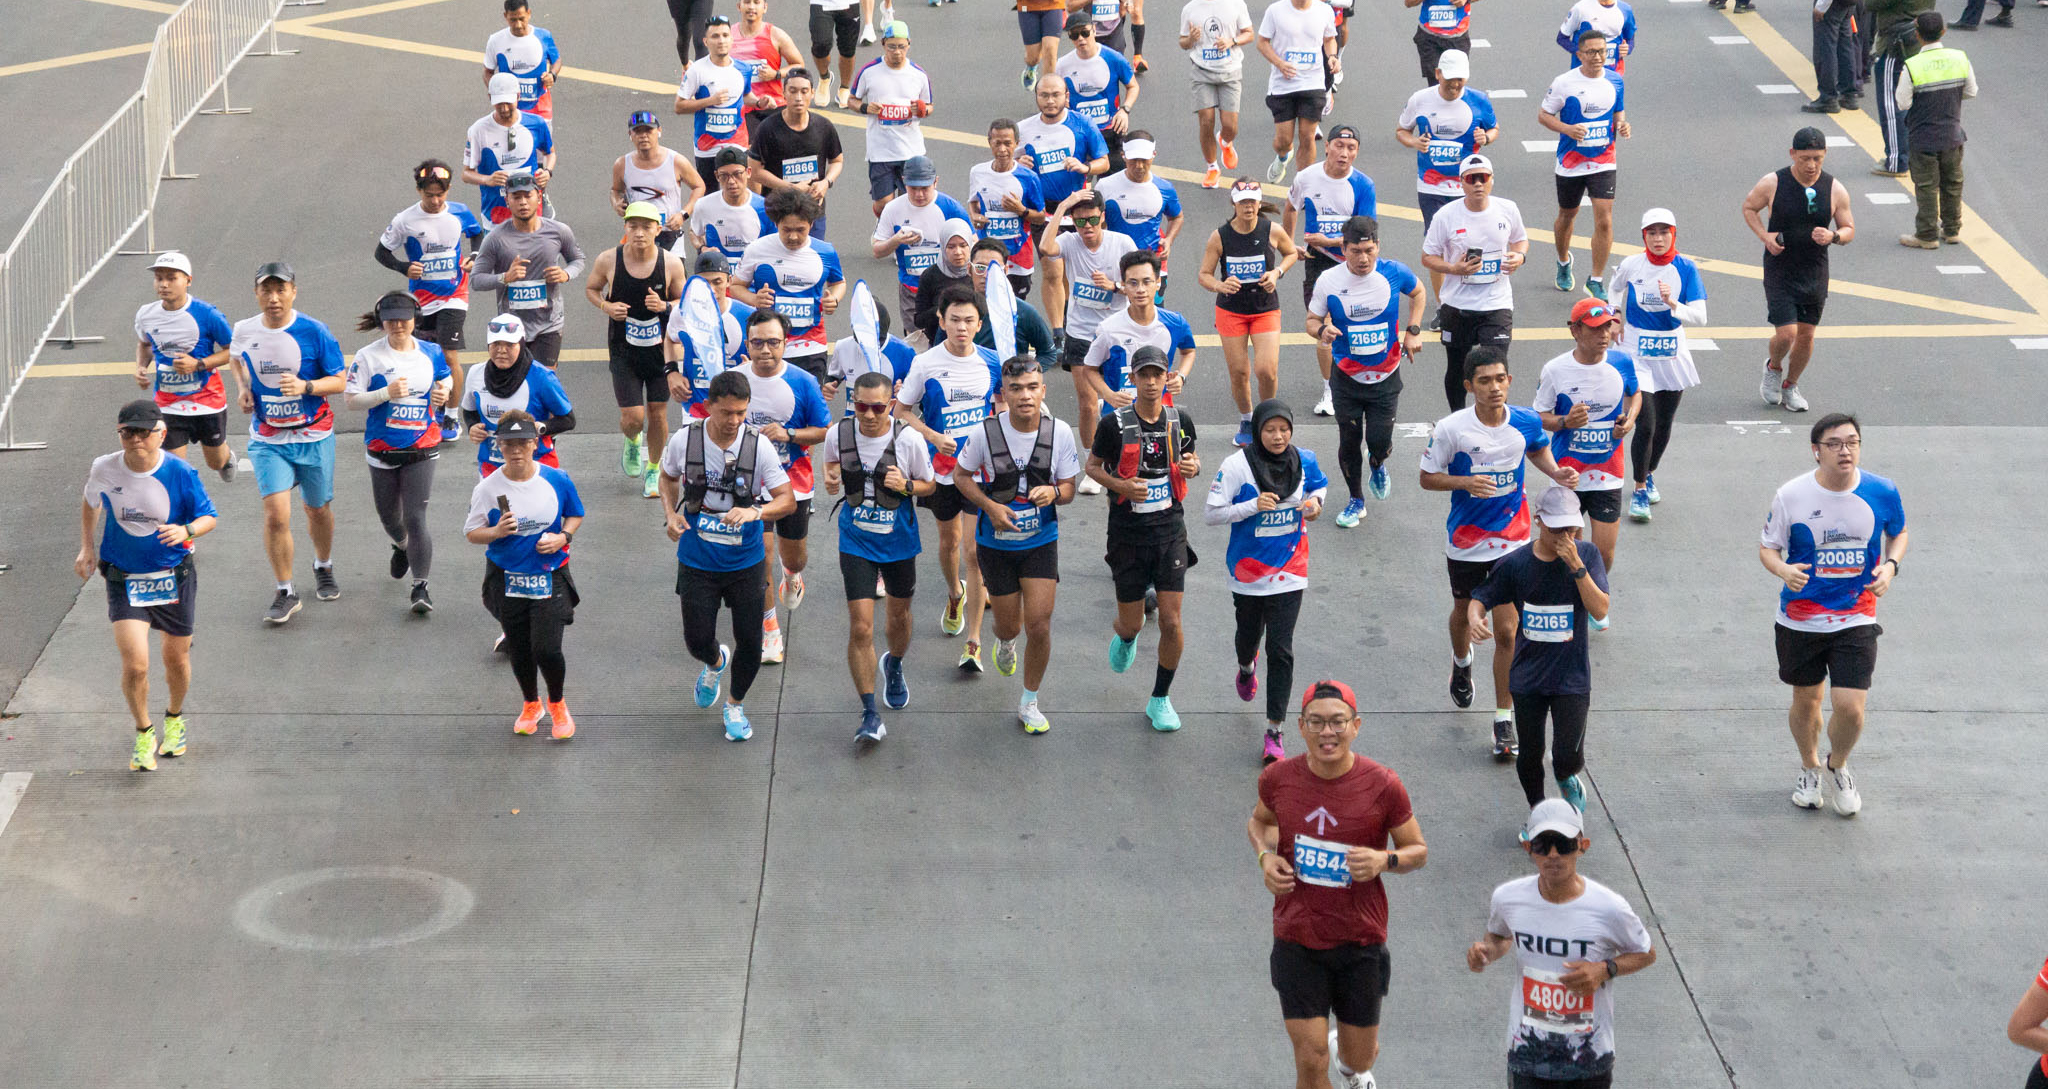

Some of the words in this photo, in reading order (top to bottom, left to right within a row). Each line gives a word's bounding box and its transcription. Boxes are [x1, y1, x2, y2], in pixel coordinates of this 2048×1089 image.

[1430, 11, 1454, 20] 21708
[520, 85, 534, 94] 118
[881, 106, 909, 118] 45019
[707, 114, 734, 125] 21606
[1585, 127, 1607, 139] 2469
[1040, 149, 1067, 164] 21316
[1430, 146, 1461, 157] 25482
[785, 163, 814, 175] 21866
[987, 218, 1019, 229] 25449
[423, 259, 455, 271] 21476
[1229, 263, 1263, 274] 25292
[512, 288, 541, 299] 21291
[1077, 285, 1107, 300] 22177
[778, 304, 811, 317] 22145
[627, 325, 659, 338] 22450
[1351, 331, 1386, 345] 21684
[1639, 337, 1676, 350] 25454
[161, 371, 194, 384] 22201
[265, 403, 300, 416] 20102
[391, 406, 427, 419] 20157
[945, 409, 985, 427] 22042
[1573, 430, 1611, 443] 25001
[1490, 472, 1514, 485] 466
[1147, 486, 1169, 500] 286
[853, 507, 894, 522] PACER
[1261, 510, 1294, 525] 21214
[698, 517, 742, 533] PACER
[1016, 518, 1040, 530] CER
[1817, 550, 1865, 565] 20085
[129, 579, 175, 595] 25240
[508, 575, 547, 588] 25136
[1527, 614, 1569, 629] 22165
[1296, 847, 1351, 872] 25544
[1515, 931, 1595, 957] RIOT
[1530, 984, 1584, 1010] 48001
